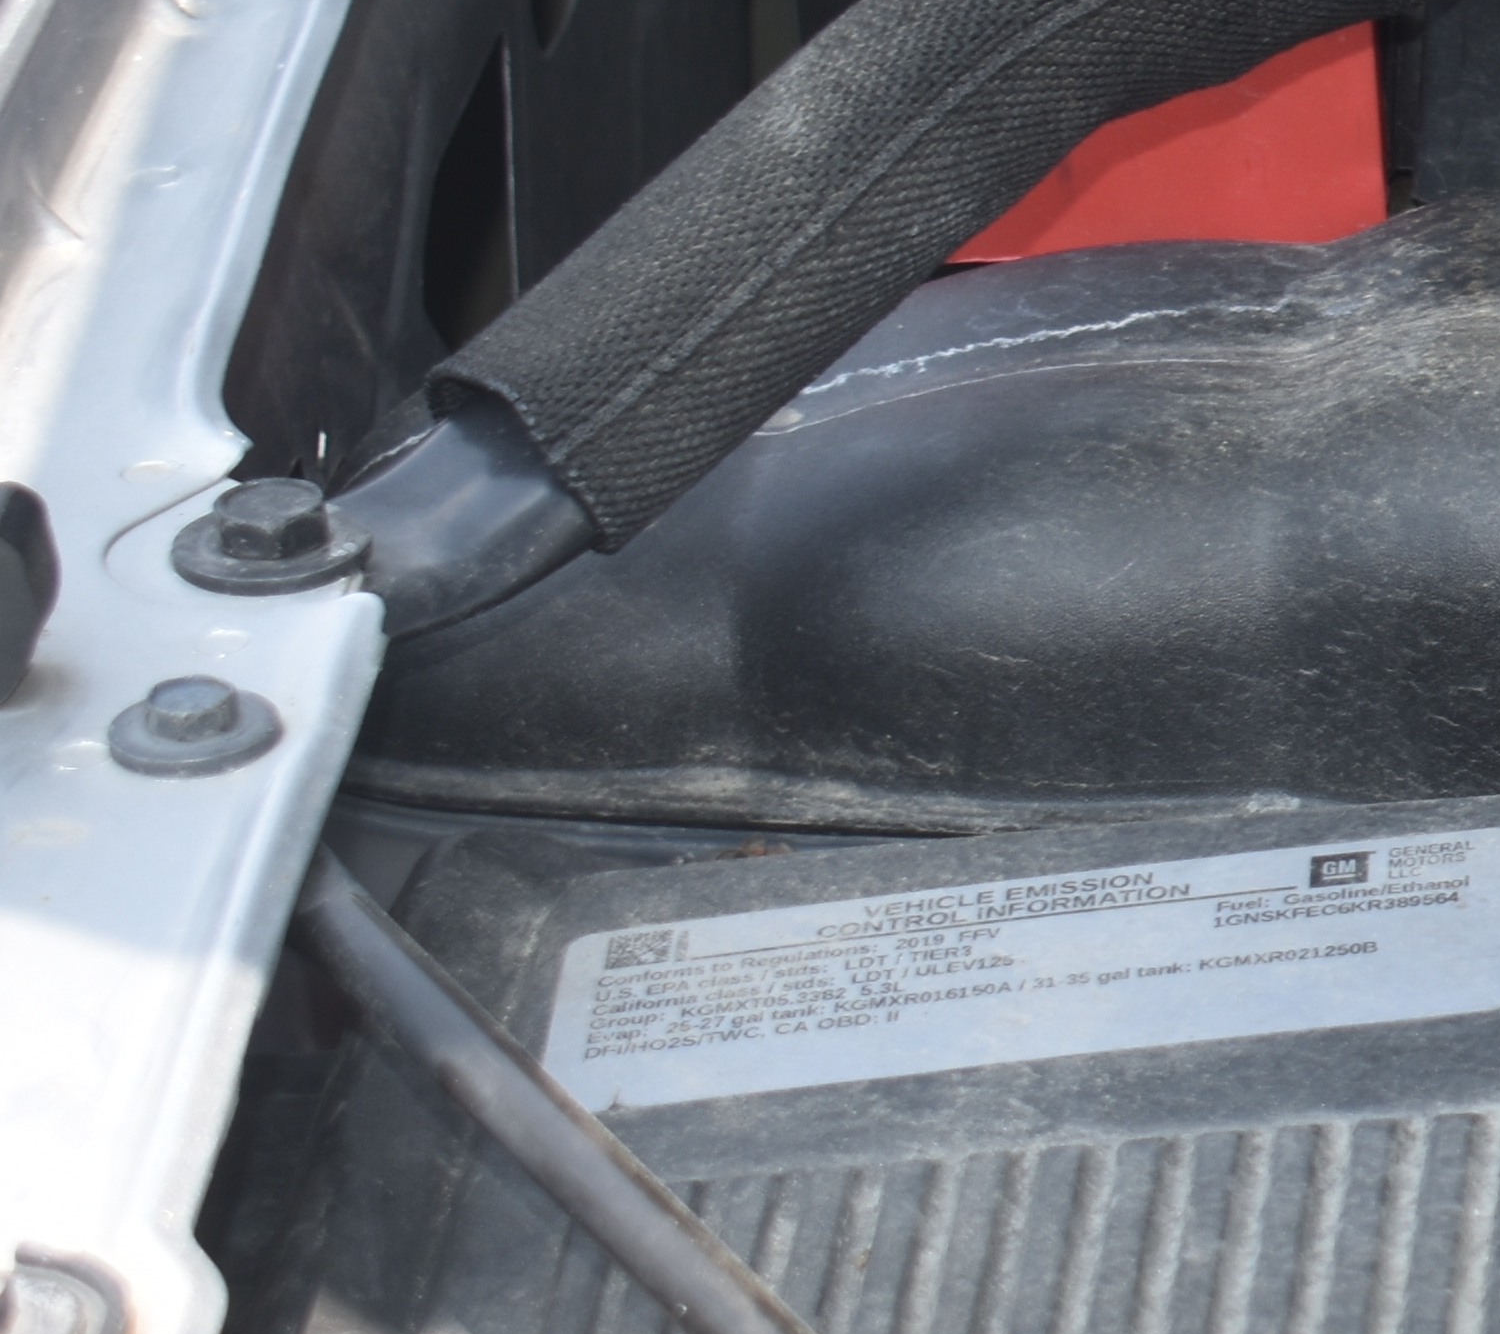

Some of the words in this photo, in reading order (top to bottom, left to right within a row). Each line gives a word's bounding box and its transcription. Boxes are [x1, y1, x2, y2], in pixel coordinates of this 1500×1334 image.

[1322, 859, 1356, 875] GM
[1388, 852, 1466, 868] MOTORS
[1389, 840, 1475, 858] GENERAL
[1388, 867, 1421, 878] LLC
[816, 912, 967, 937] CONTROL
[975, 885, 1191, 918] INFORMATION
[862, 893, 994, 916] VEHICLE
[1005, 873, 1154, 899] EMISSION
[1217, 897, 1270, 913] Fuel:
[1283, 876, 1470, 905] Gasoline/Ethanol
[594, 987, 637, 1001] U.S.
[646, 981, 689, 994] EPA
[698, 972, 753, 987] class
[773, 963, 829, 977] stds:
[844, 956, 886, 969] LDT
[912, 946, 972, 960] TIER3
[596, 966, 706, 984] Conforms
[711, 960, 733, 971] to
[740, 944, 878, 966] Regulations:
[895, 934, 944, 949] 2019
[959, 928, 1000, 941] FFV
[586, 1029, 648, 1043] Evap:
[665, 1018, 725, 1032] 25-27
[731, 1013, 764, 1029] gal
[771, 1005, 826, 1020] tank:
[1097, 967, 1130, 984] gal
[1136, 961, 1193, 976] tank:
[589, 1012, 666, 1028] Group:
[859, 982, 905, 995] 5.3L
[591, 995, 697, 1013] California
[705, 986, 760, 1000] class
[782, 976, 836, 991] stds:
[851, 969, 893, 983] LDT
[915, 957, 1014, 973] ULEV125
[774, 1021, 809, 1033] CA
[818, 1013, 879, 1028] OBD:
